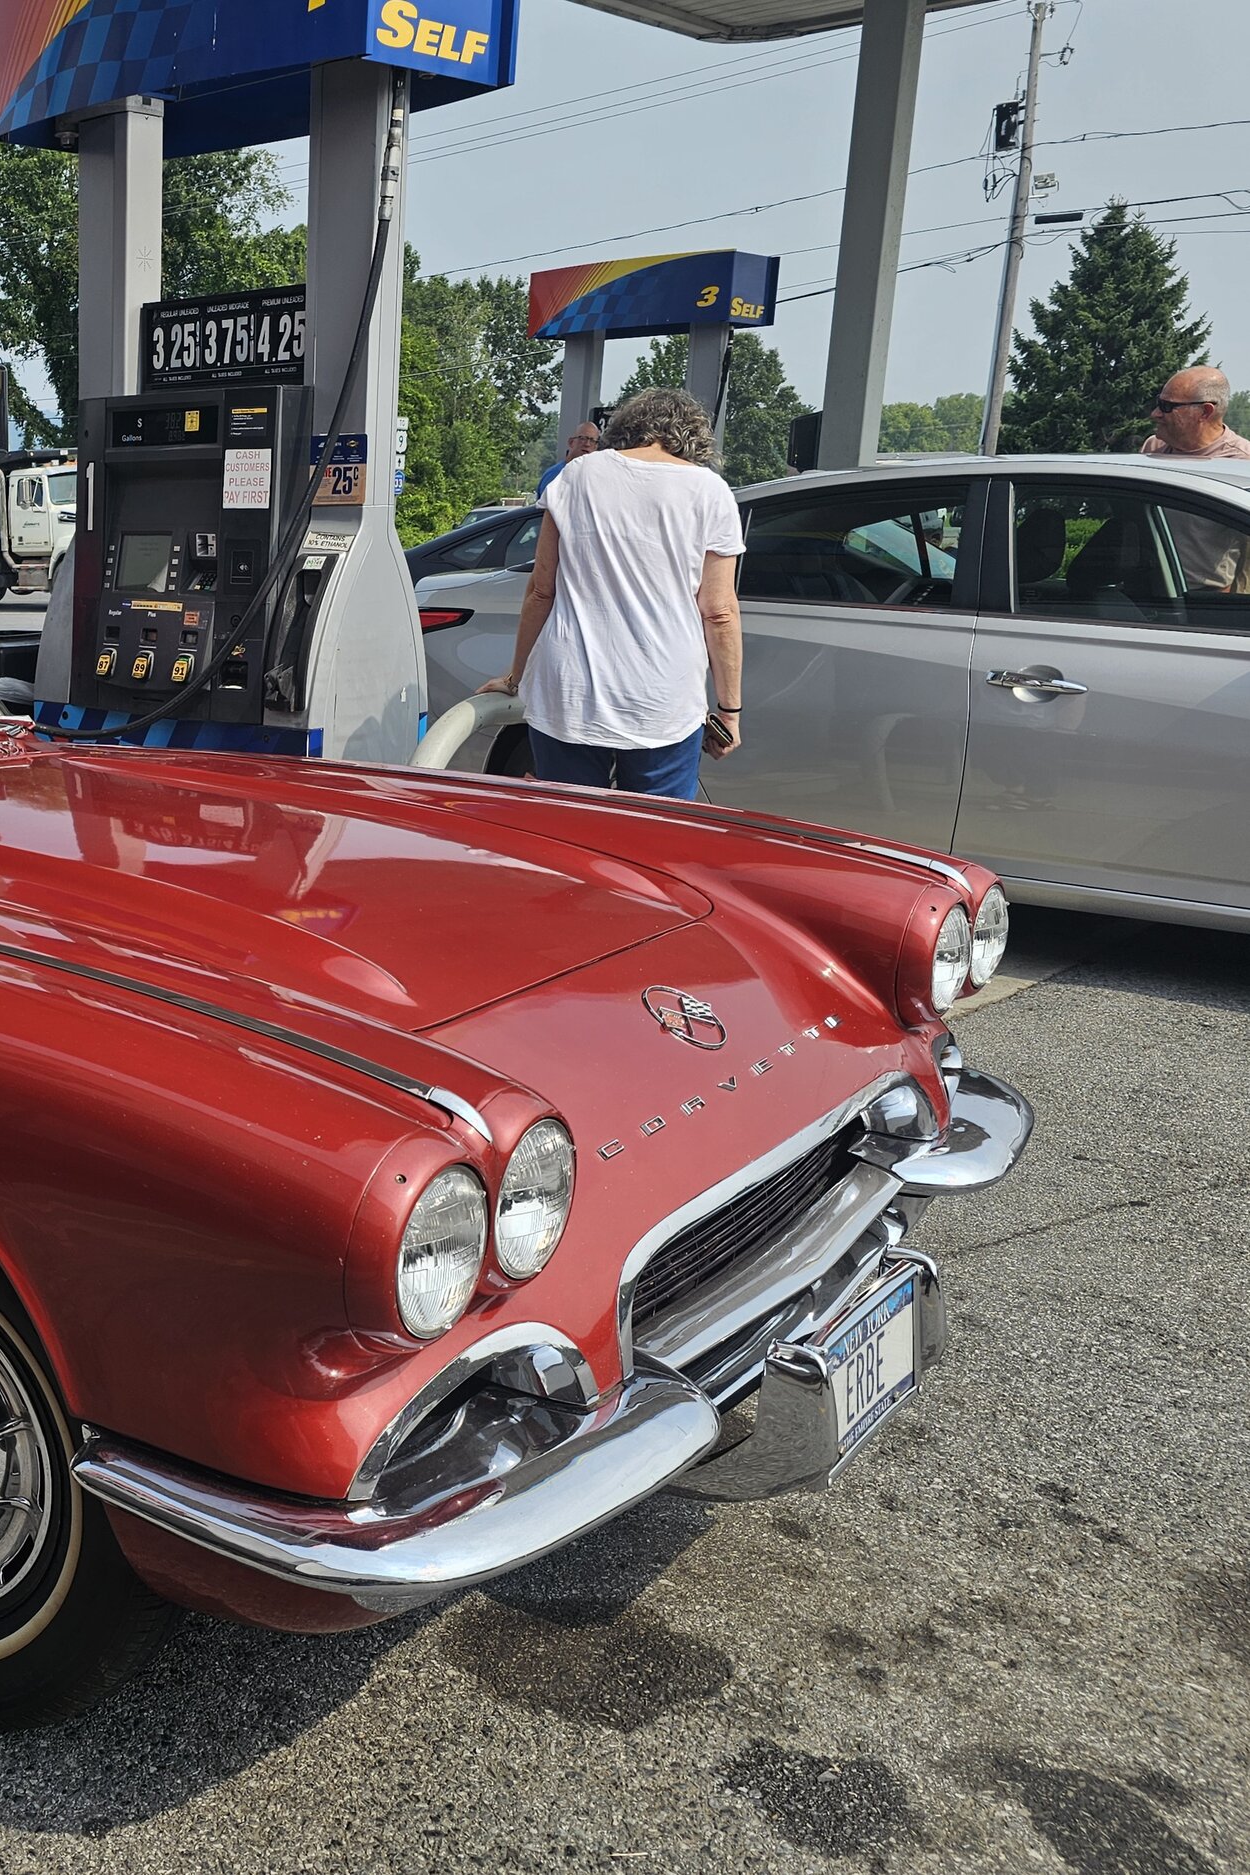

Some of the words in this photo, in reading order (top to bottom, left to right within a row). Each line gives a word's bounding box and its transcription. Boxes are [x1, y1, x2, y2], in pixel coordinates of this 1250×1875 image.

[376, 0, 489, 64] SELF
[696, 286, 720, 307] 3
[731, 297, 765, 319] SELF
[137, 418, 143, 428] $
[122, 434, 143, 442] Gallons
[235, 451, 261, 459] CASH
[226, 463, 269, 472] CUSTOMERS
[229, 478, 264, 486] PLEASE
[86, 462, 94, 530] 1
[224, 491, 240, 504] PAY
[242, 491, 268, 504] FIRST
[315, 533, 346, 542] CONTAINS
[320, 540, 348, 548] ETHANOL
[98, 660, 109, 669] 87
[133, 664, 145, 673] 89
[174, 667, 185, 676] 91
[597, 1013, 843, 1161] CORVETTE
[842, 1320, 864, 1360] NEW
[865, 1304, 891, 1337] YORK
[846, 1330, 885, 1426] ERBE
[875, 1395, 892, 1419] STATE
